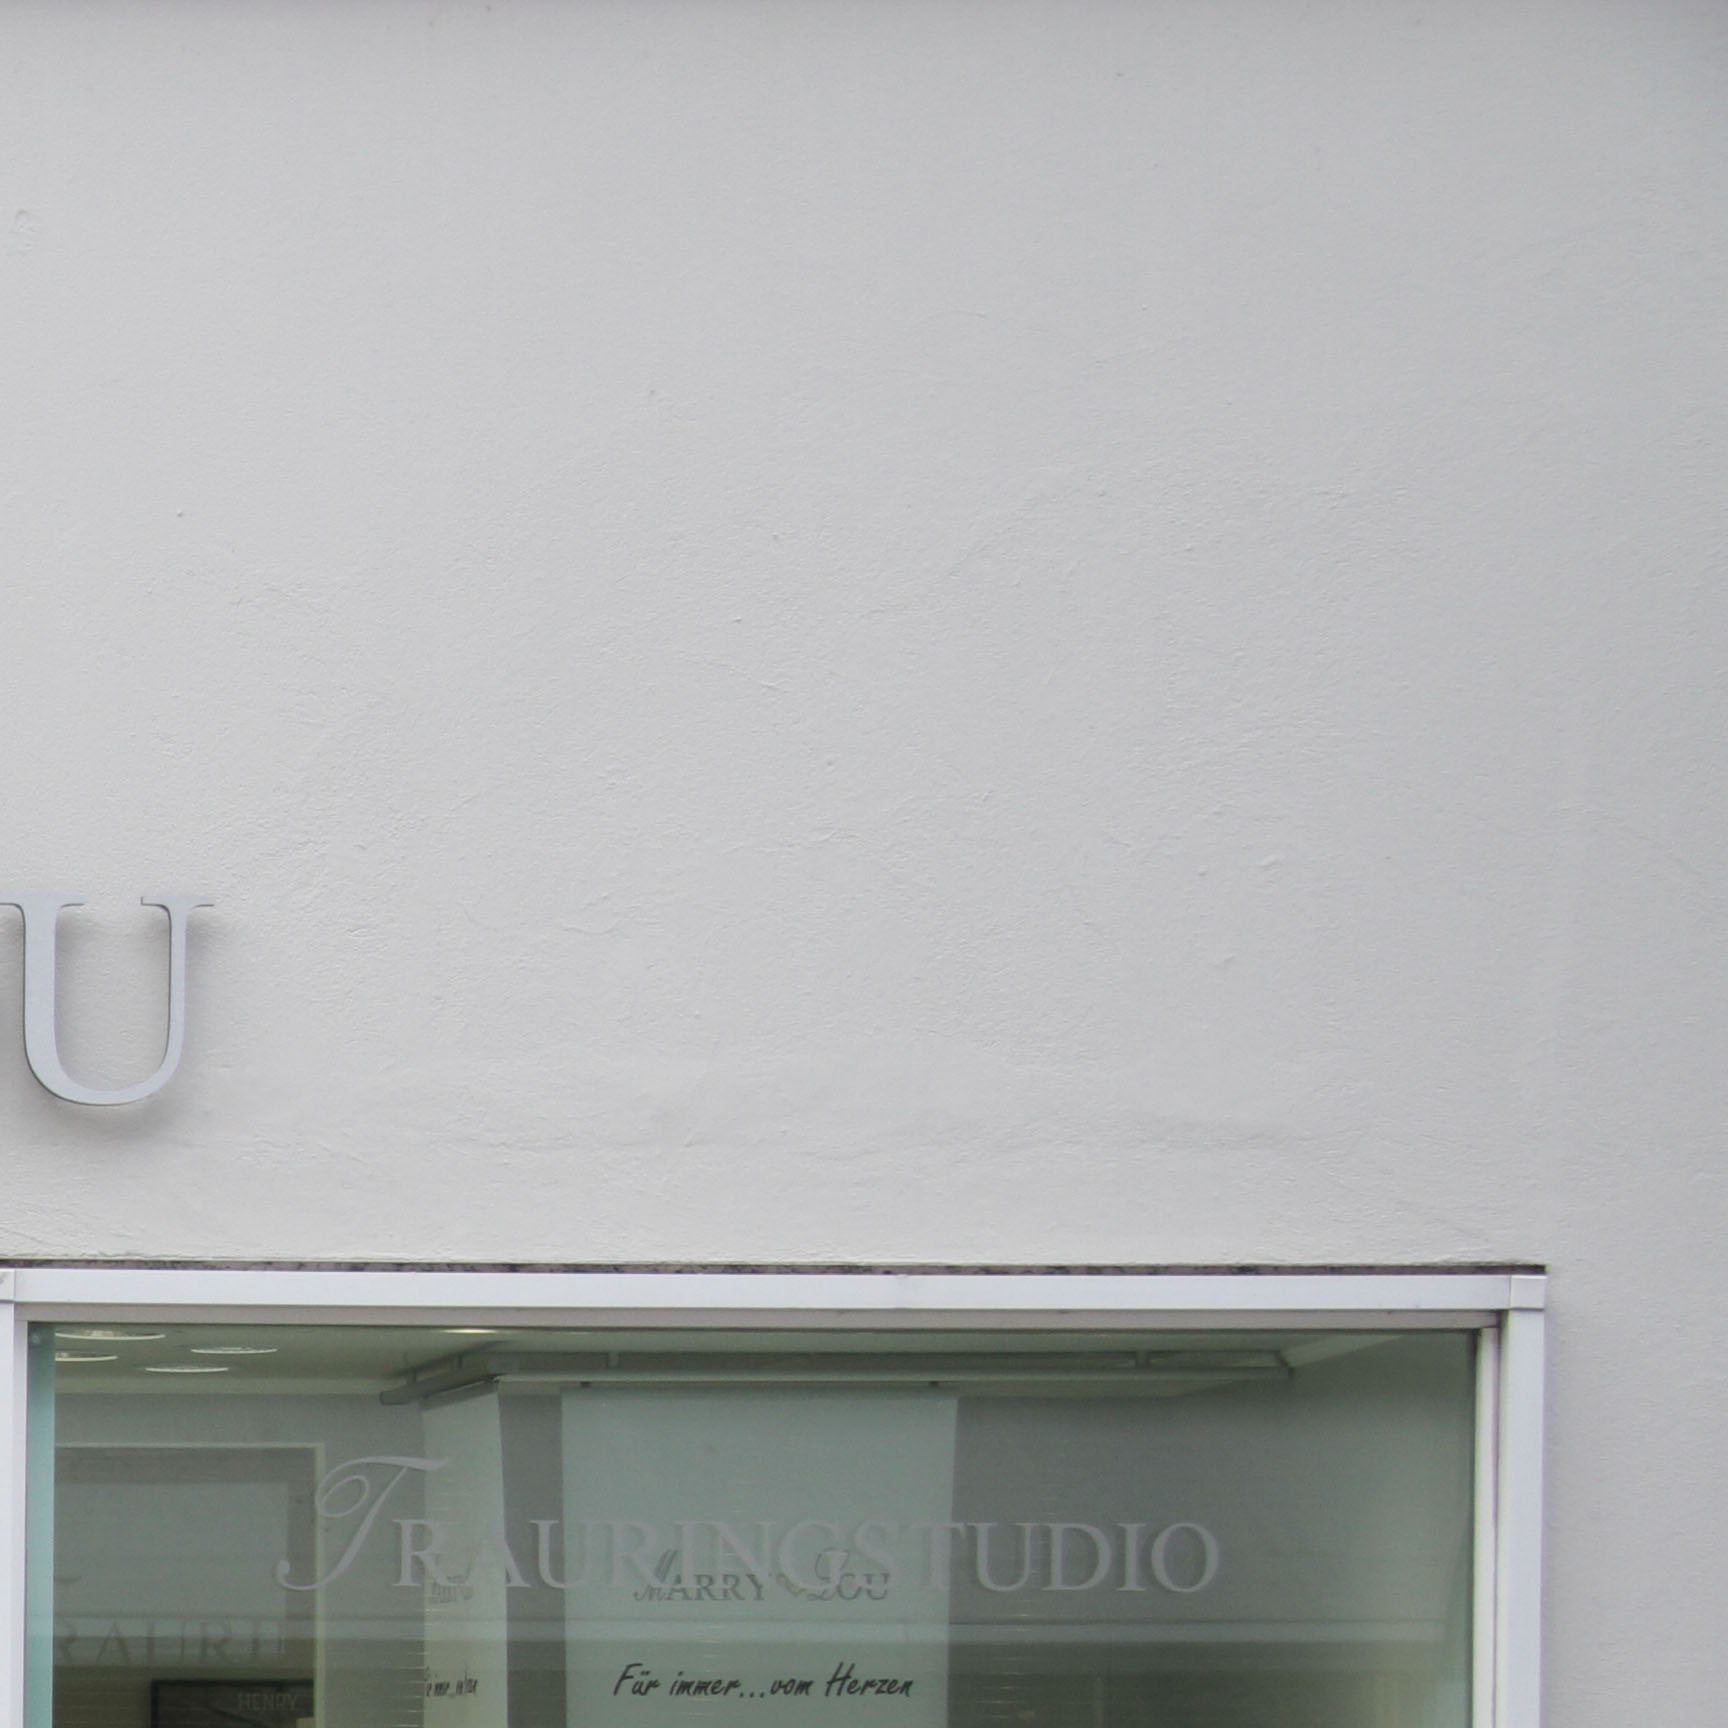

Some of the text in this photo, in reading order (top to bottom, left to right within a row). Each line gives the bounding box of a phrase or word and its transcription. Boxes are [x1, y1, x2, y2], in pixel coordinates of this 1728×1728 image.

[275, 1456, 1221, 1595] TRAURINGSTUDIO
[613, 1662, 660, 1698] Für
[824, 1661, 915, 1699] Herzen
